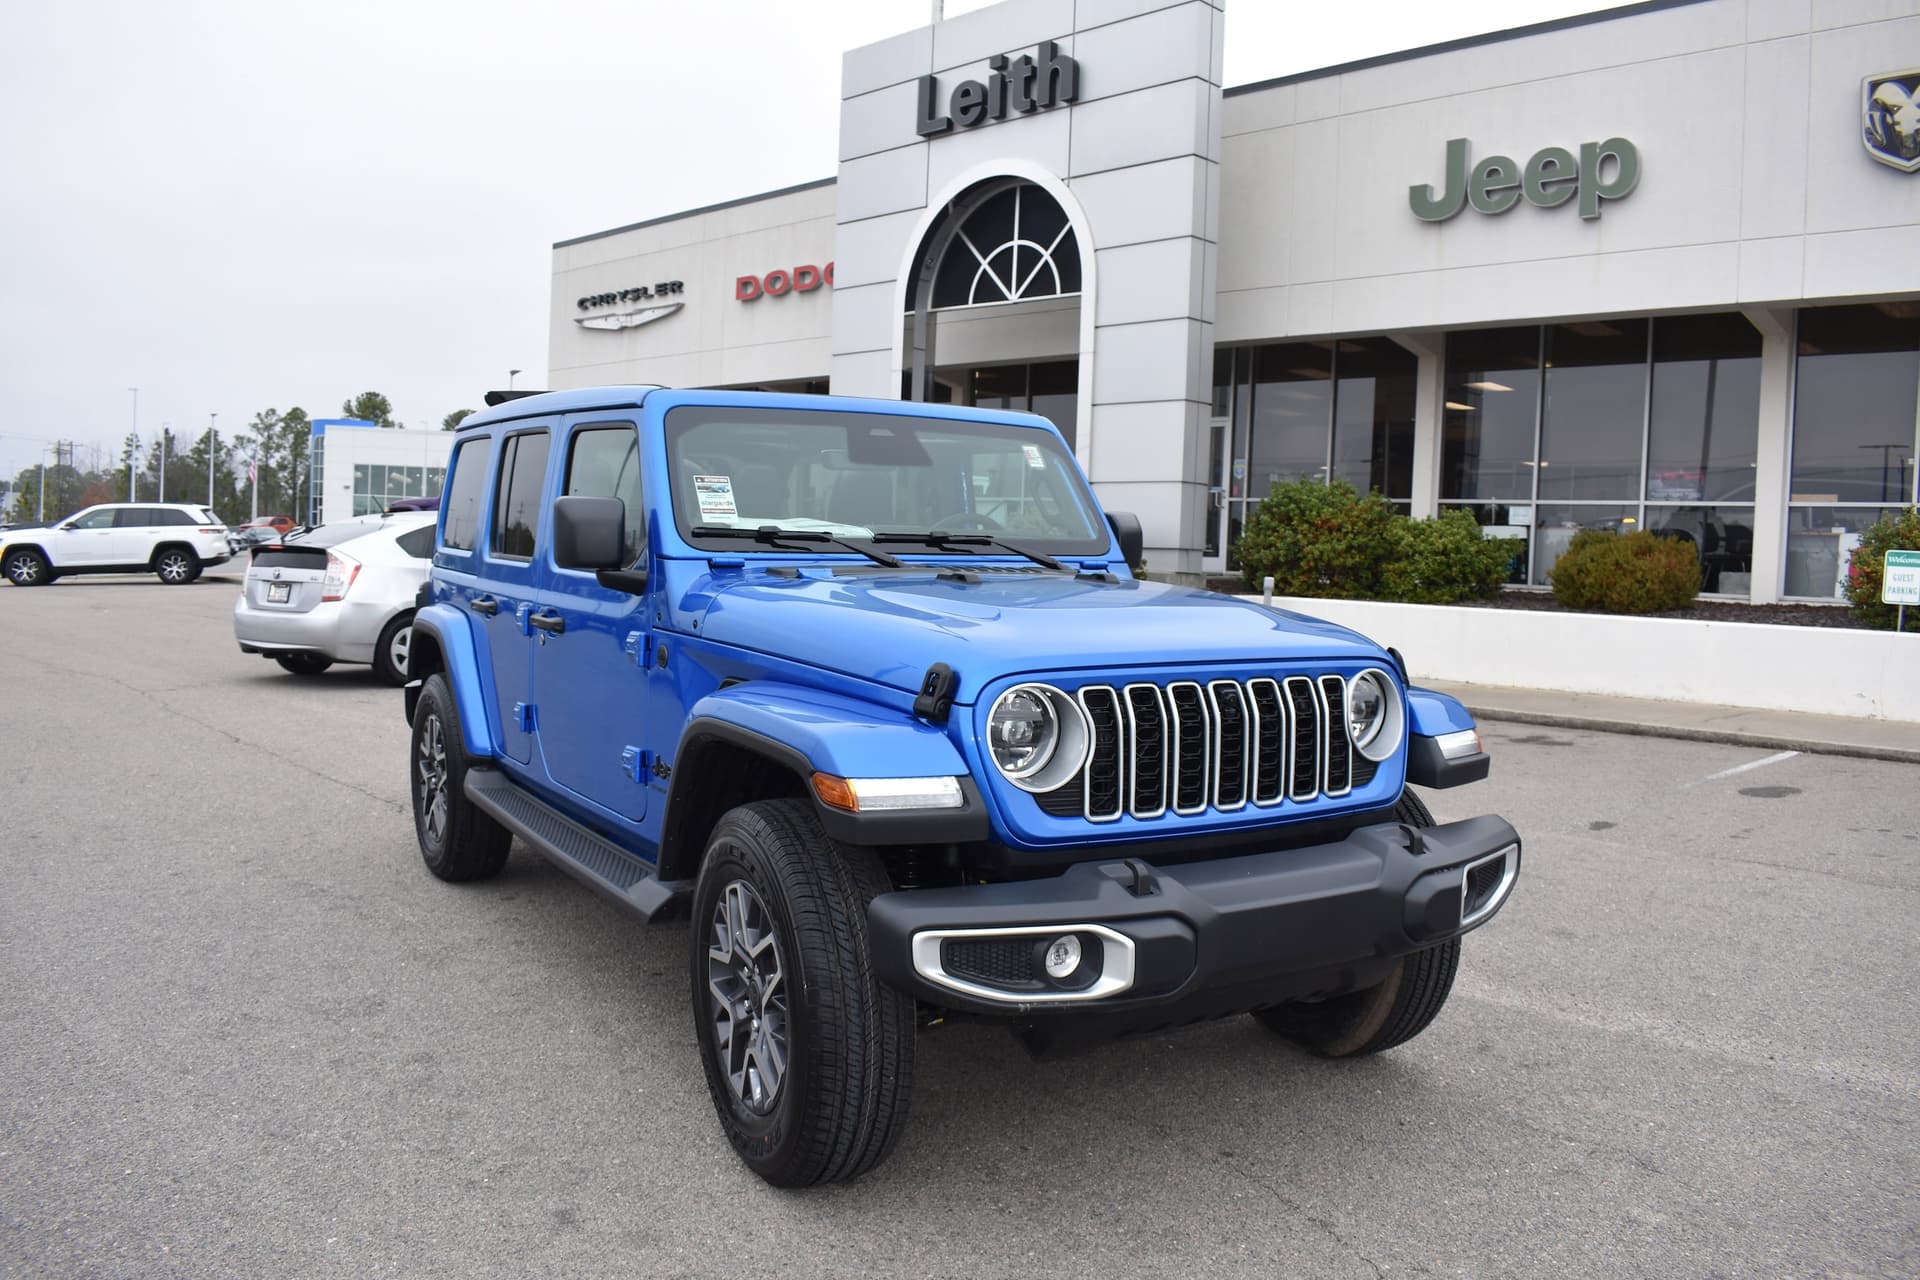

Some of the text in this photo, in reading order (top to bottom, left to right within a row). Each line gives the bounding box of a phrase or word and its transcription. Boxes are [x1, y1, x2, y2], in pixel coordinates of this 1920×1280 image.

[916, 39, 1081, 138] Leith
[1409, 137, 1641, 221] Jeep
[577, 280, 685, 311] CHRYSLER
[1888, 585, 1918, 595] PARKING
[1892, 573, 1914, 582] GUEST
